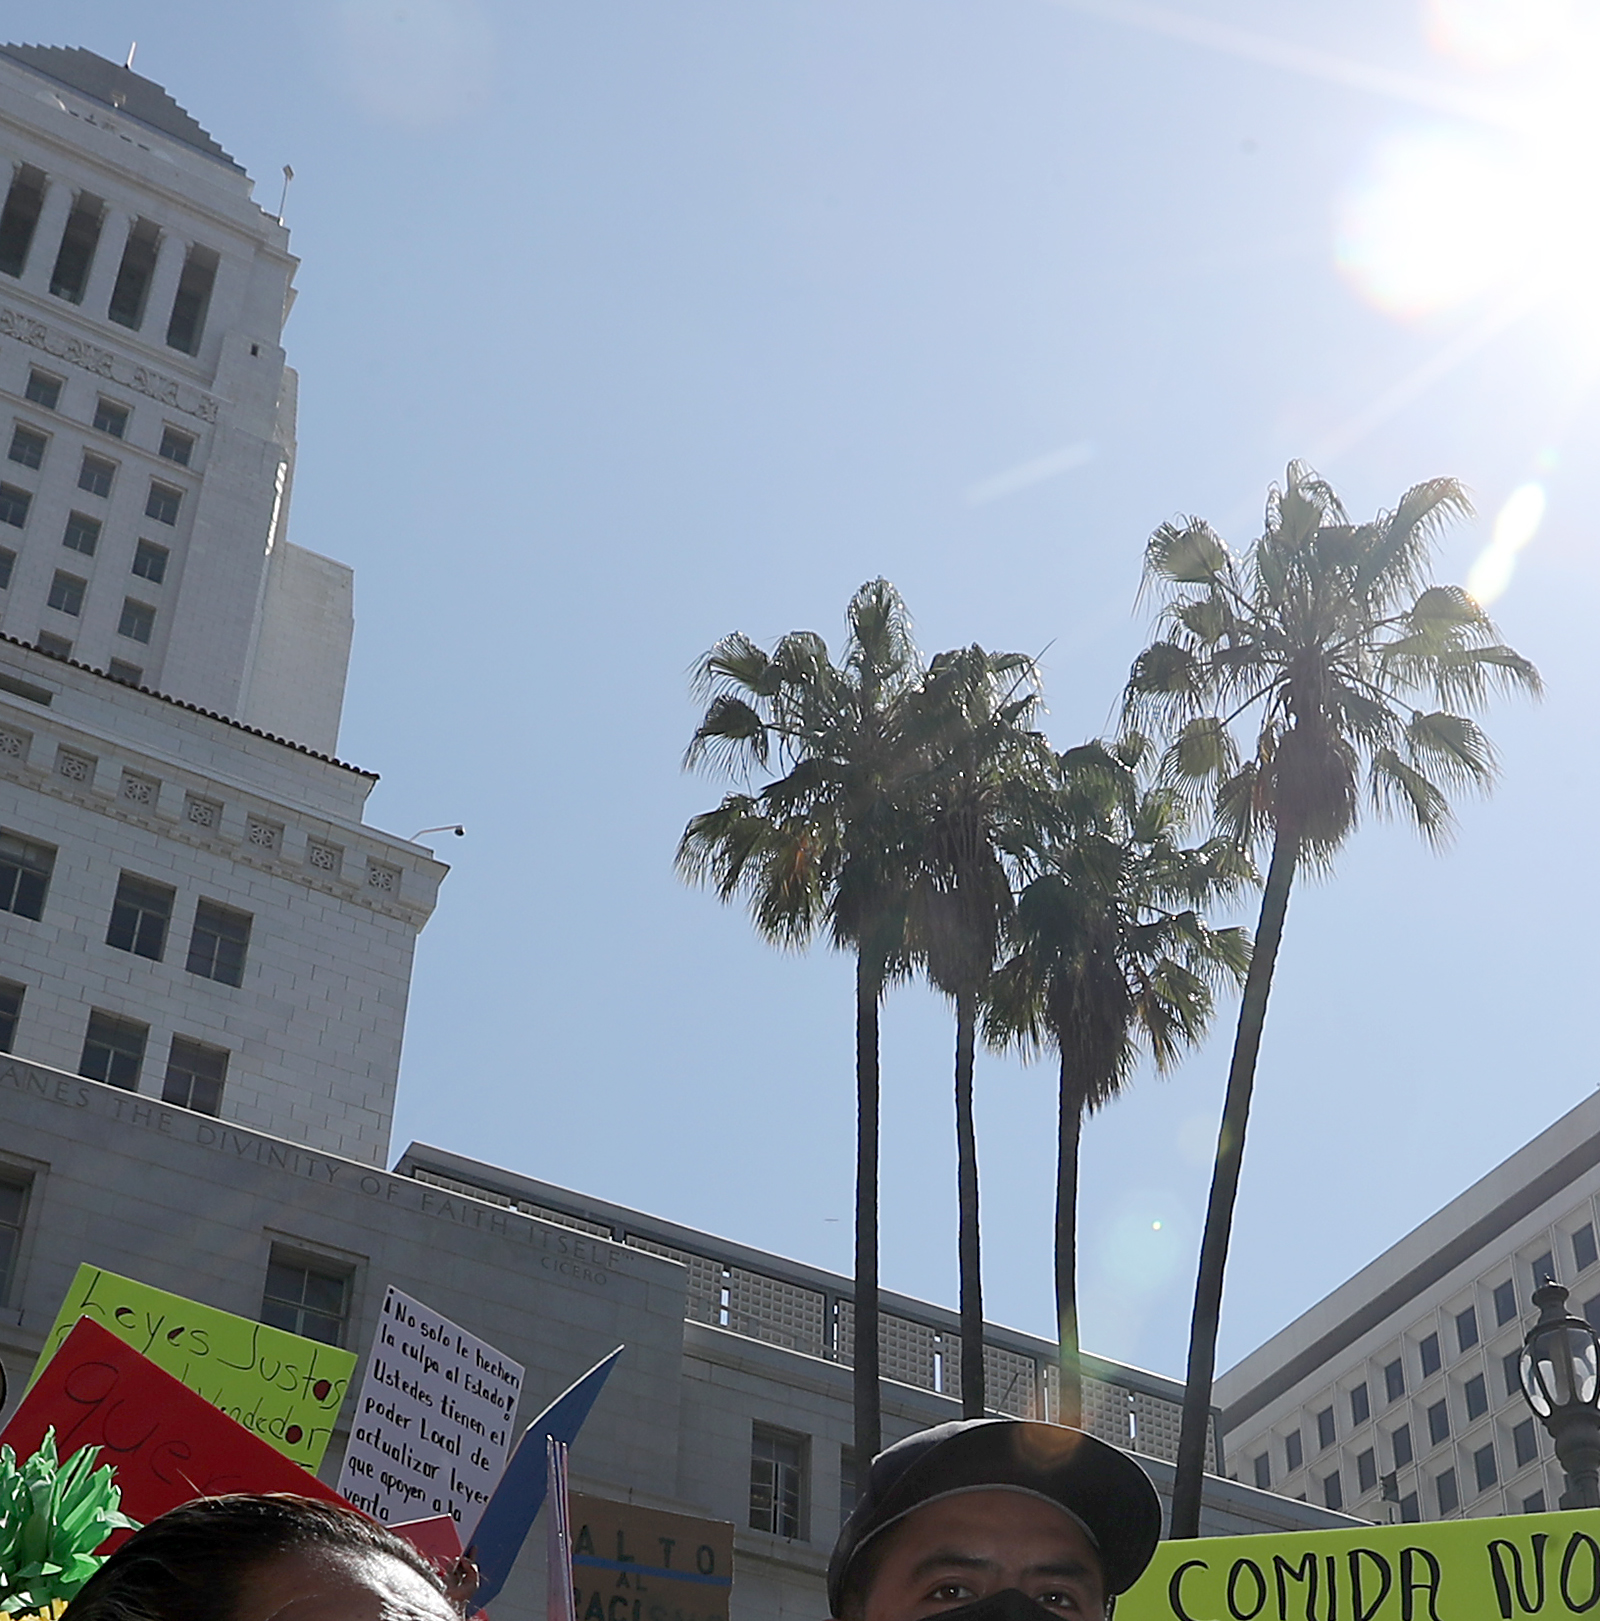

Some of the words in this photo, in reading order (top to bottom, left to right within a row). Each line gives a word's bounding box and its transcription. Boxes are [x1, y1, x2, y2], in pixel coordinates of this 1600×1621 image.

[113, 1097, 174, 1133] THE
[196, 1124, 341, 1185] DIVINITY
[360, 1175, 400, 1201] OF
[420, 1192, 508, 1236] FAITH
[541, 1256, 608, 1286] CICERO
[79, 1271, 211, 1356] Leyes
[216, 1324, 349, 1410] Justas
[380, 1324, 395, 1347] la
[401, 1342, 439, 1374] culpa
[445, 1367, 459, 1384] al
[464, 1374, 515, 1422] Estado!
[420, 1324, 451, 1347] solo
[456, 1336, 469, 1359] le
[476, 1349, 520, 1391] hechen
[198, 1387, 332, 1452] ndedor
[365, 1396, 412, 1430] poder
[420, 1417, 462, 1457] Local
[470, 1446, 491, 1472] de
[373, 1358, 433, 1408] Ustedes
[440, 1395, 486, 1438] tienen
[490, 1430, 506, 1447] el
[356, 1426, 440, 1480] actualizar
[343, 1487, 390, 1522] venta
[348, 1455, 375, 1479] que
[380, 1468, 426, 1504] apoyen
[432, 1497, 442, 1513] a
[447, 1499, 462, 1523] la
[574, 1524, 716, 1575] ALTO
[616, 1571, 648, 1592] AL
